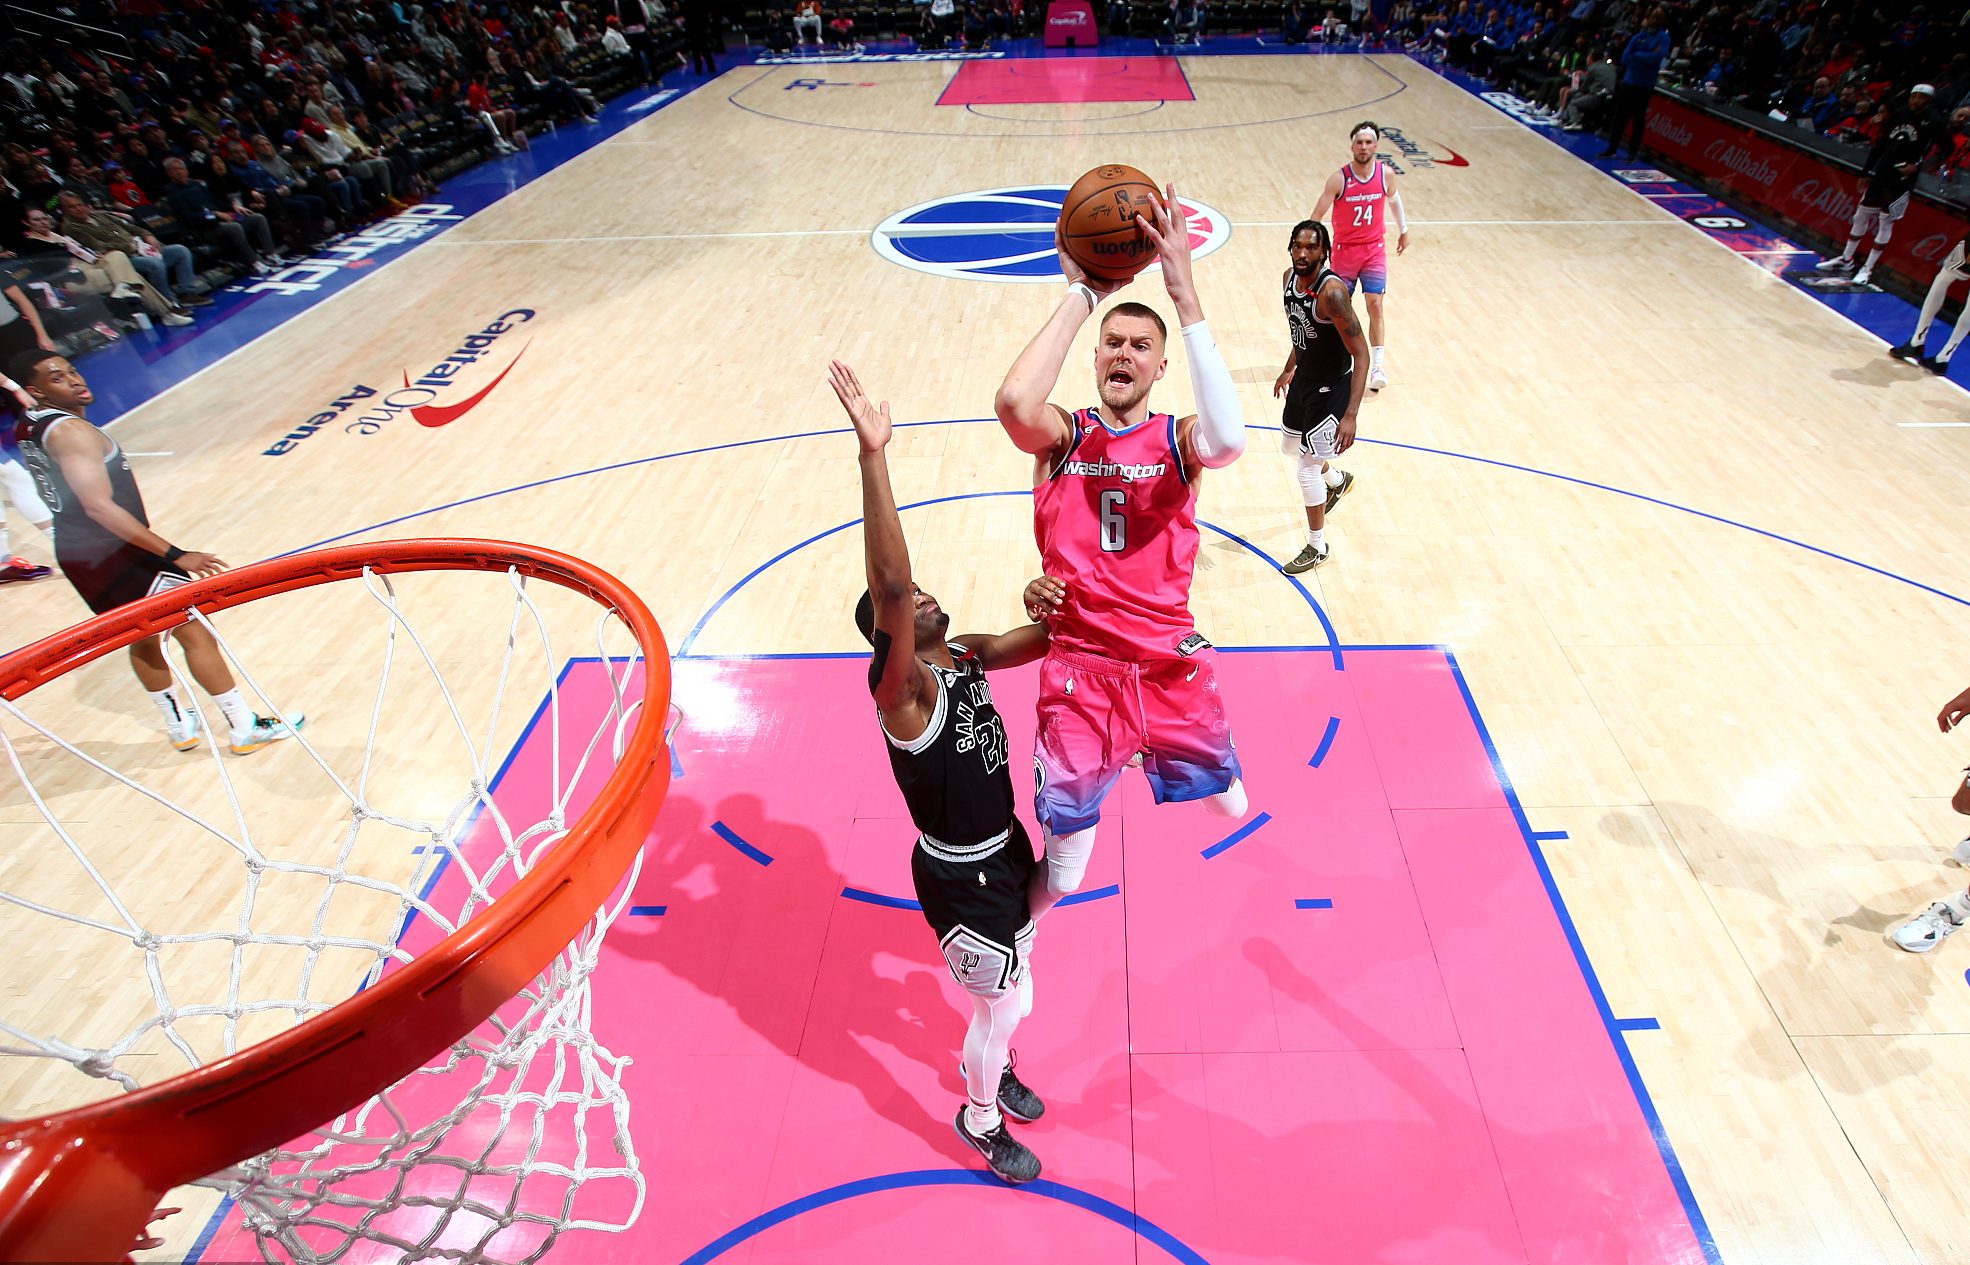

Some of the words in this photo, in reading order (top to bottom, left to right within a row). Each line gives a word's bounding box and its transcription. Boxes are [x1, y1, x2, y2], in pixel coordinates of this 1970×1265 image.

[1646, 112, 1693, 147] Alibaba
[1719, 144, 1778, 186] Alibaba
[1353, 204, 1373, 227] 24
[244, 203, 464, 296] district
[416, 308, 535, 387] Capital
[261, 384, 378, 456] Arena
[345, 388, 437, 435] One
[1063, 456, 1166, 484] washington
[1100, 489, 1126, 552] 6
[956, 701, 975, 753] SAN
